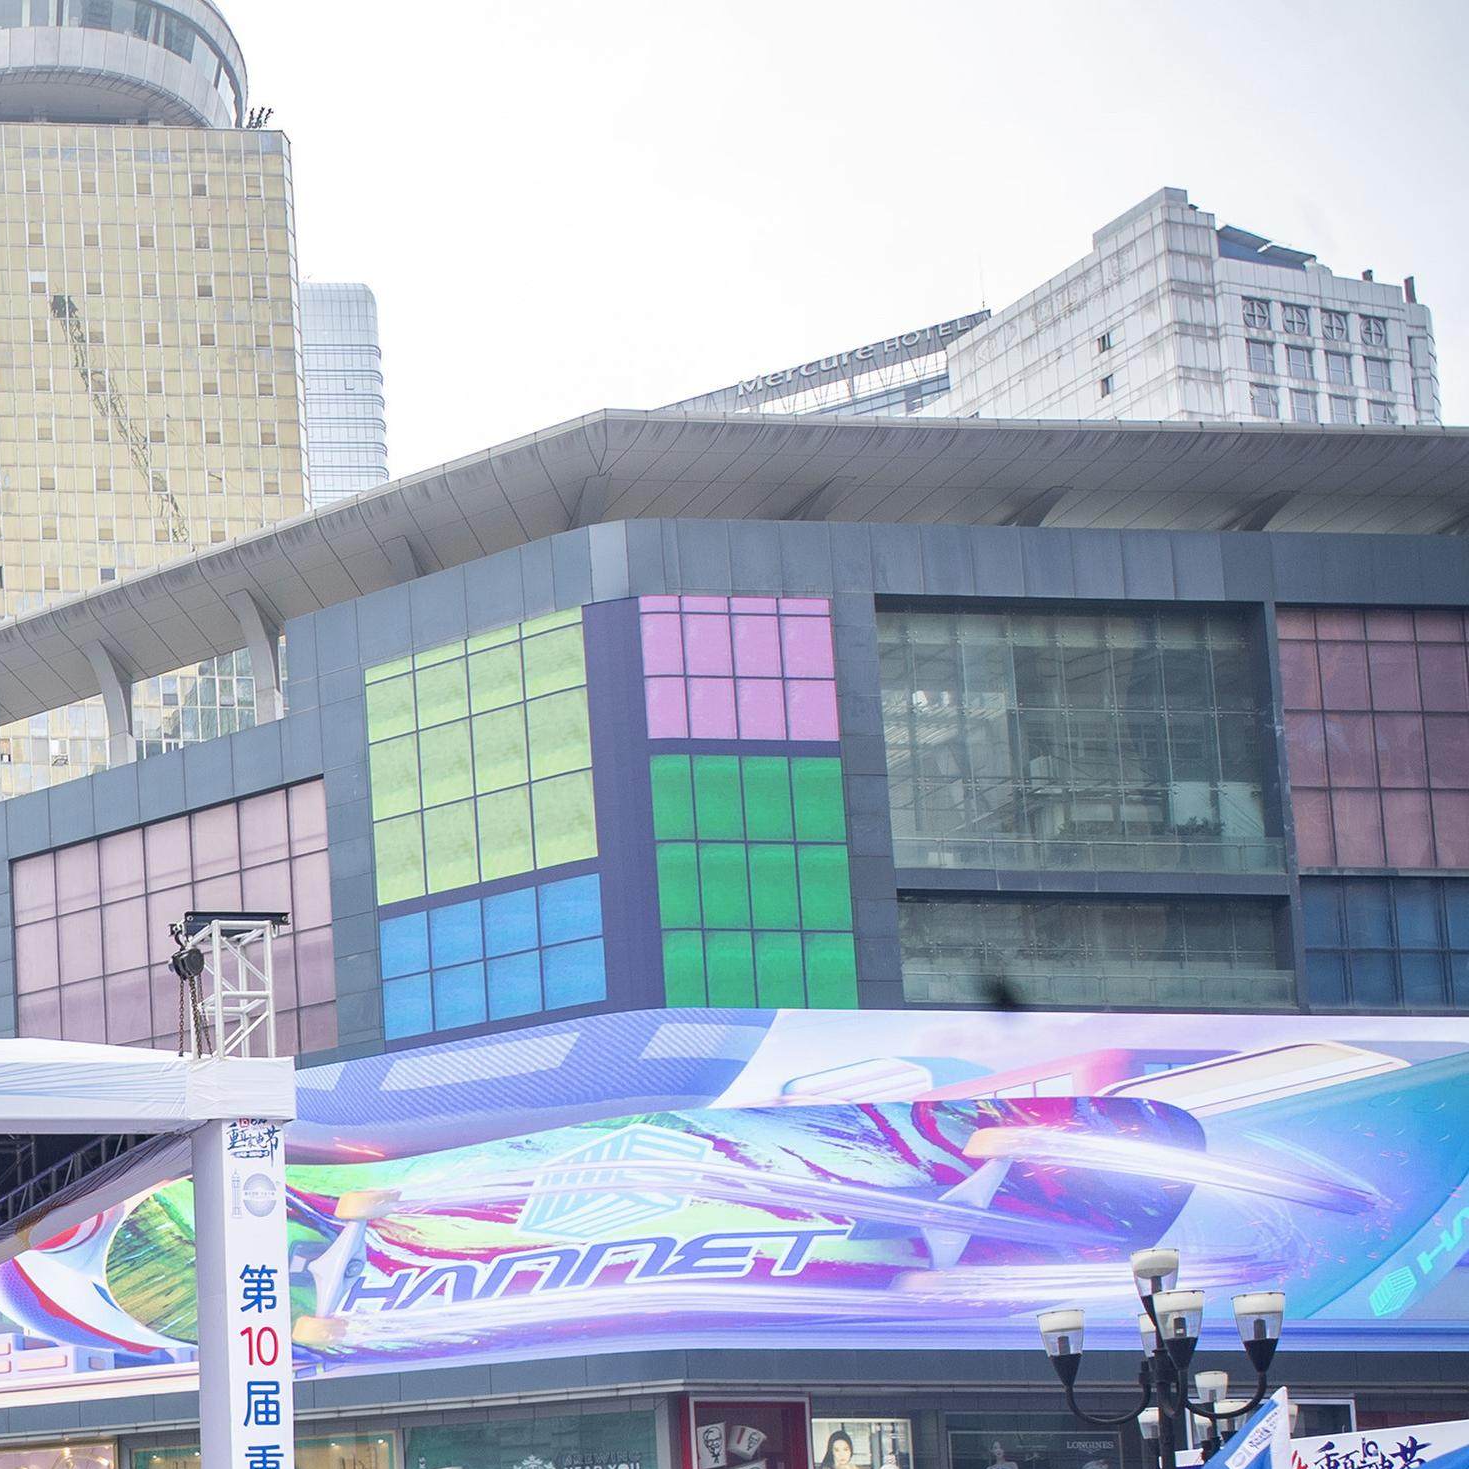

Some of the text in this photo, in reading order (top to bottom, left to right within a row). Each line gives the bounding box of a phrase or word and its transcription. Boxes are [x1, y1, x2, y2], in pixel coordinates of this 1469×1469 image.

[737, 320, 969, 397] Mercure HOTEL
[1066, 1440, 1115, 1450] LONGINES
